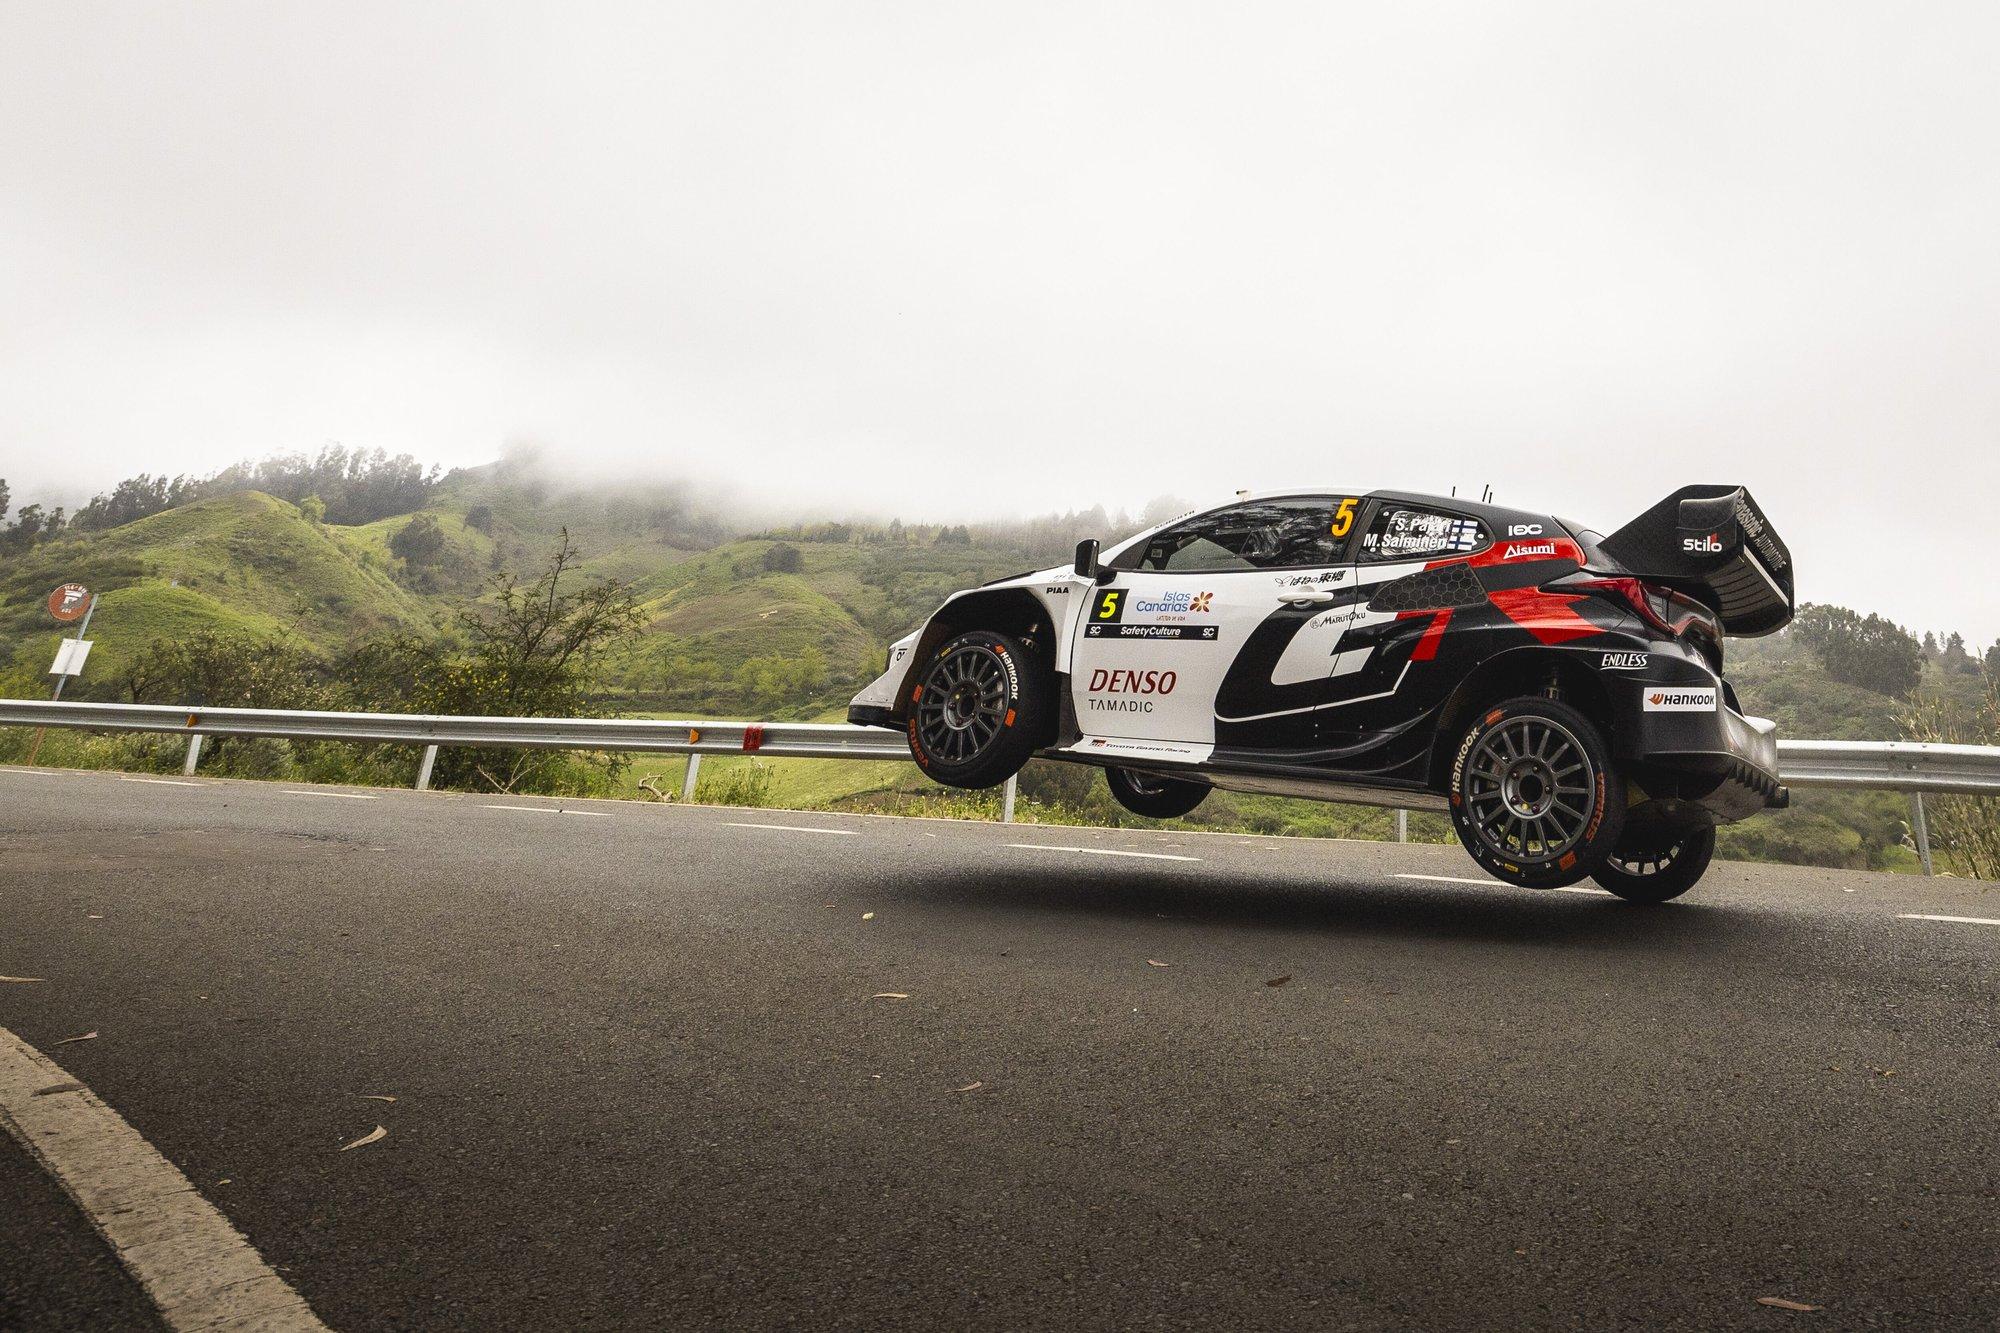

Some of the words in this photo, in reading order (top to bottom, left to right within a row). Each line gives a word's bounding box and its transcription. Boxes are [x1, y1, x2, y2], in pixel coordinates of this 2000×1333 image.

[1331, 499, 1358, 537] 5
[1503, 542, 1557, 560] Aisumi
[1683, 535, 1722, 553] Stilo
[1046, 586, 1069, 594] PIAA
[1163, 591, 1191, 602] Islas
[1099, 592, 1119, 619] 5
[1136, 601, 1188, 612] Canarias
[1089, 625, 1101, 635] SC
[1202, 627, 1214, 637] SC
[1601, 653, 1649, 667] ENDLESS
[1088, 669, 1177, 695] DENSO
[1088, 698, 1153, 713] TAMADIC
